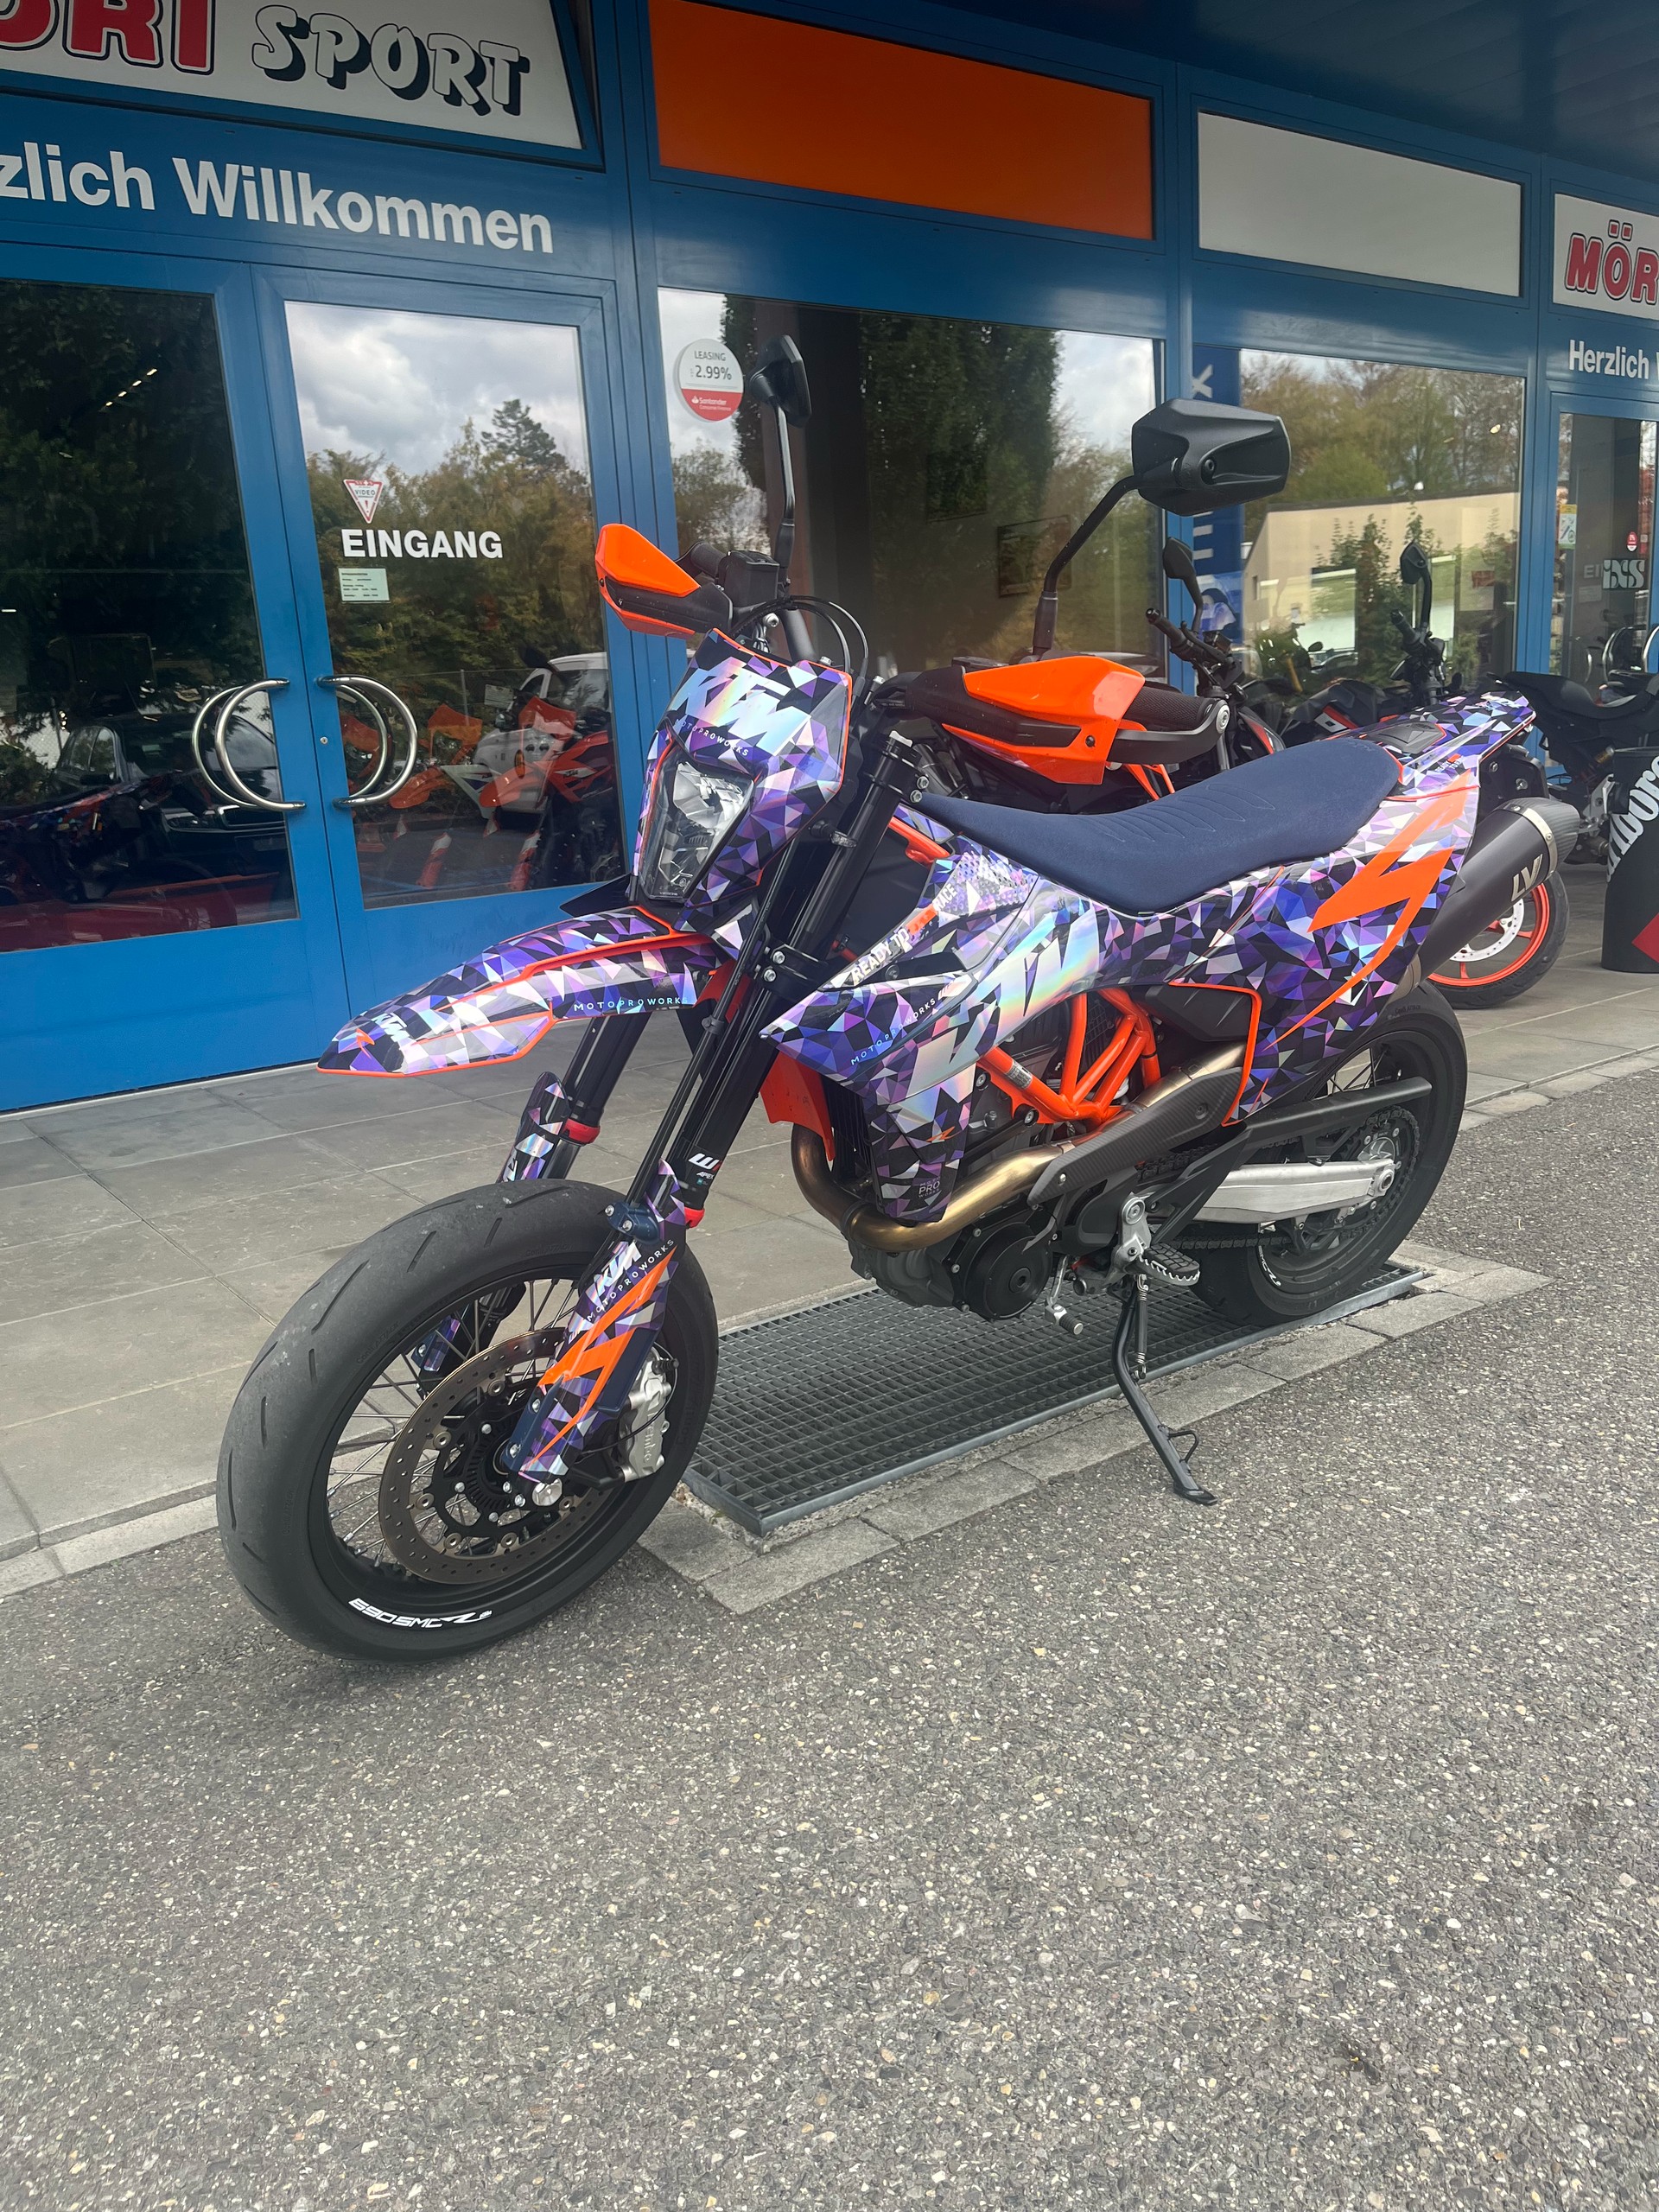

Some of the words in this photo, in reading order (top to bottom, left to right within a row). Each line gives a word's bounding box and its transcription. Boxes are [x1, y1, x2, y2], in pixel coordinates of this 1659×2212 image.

[251, 4, 531, 117] SPORT
[172, 156, 554, 255] Willkommen
[1564, 219, 1659, 306] MÖR
[694, 350, 727, 362] LEASING
[695, 365, 732, 380] 2.99%
[1568, 339, 1649, 380] Herzlich
[341, 529, 503, 559] EINGANG
[1511, 853, 1544, 894] LV
[850, 938, 893, 987] READY
[890, 928, 911, 951] TO
[932, 883, 957, 912] RACE
[574, 996, 689, 1012] MOTOPROWORKS
[850, 998, 936, 1065] MOTOPROWORKS
[918, 1180, 940, 1195] PRO
[587, 1239, 674, 1322] MOTOPROWORKS
